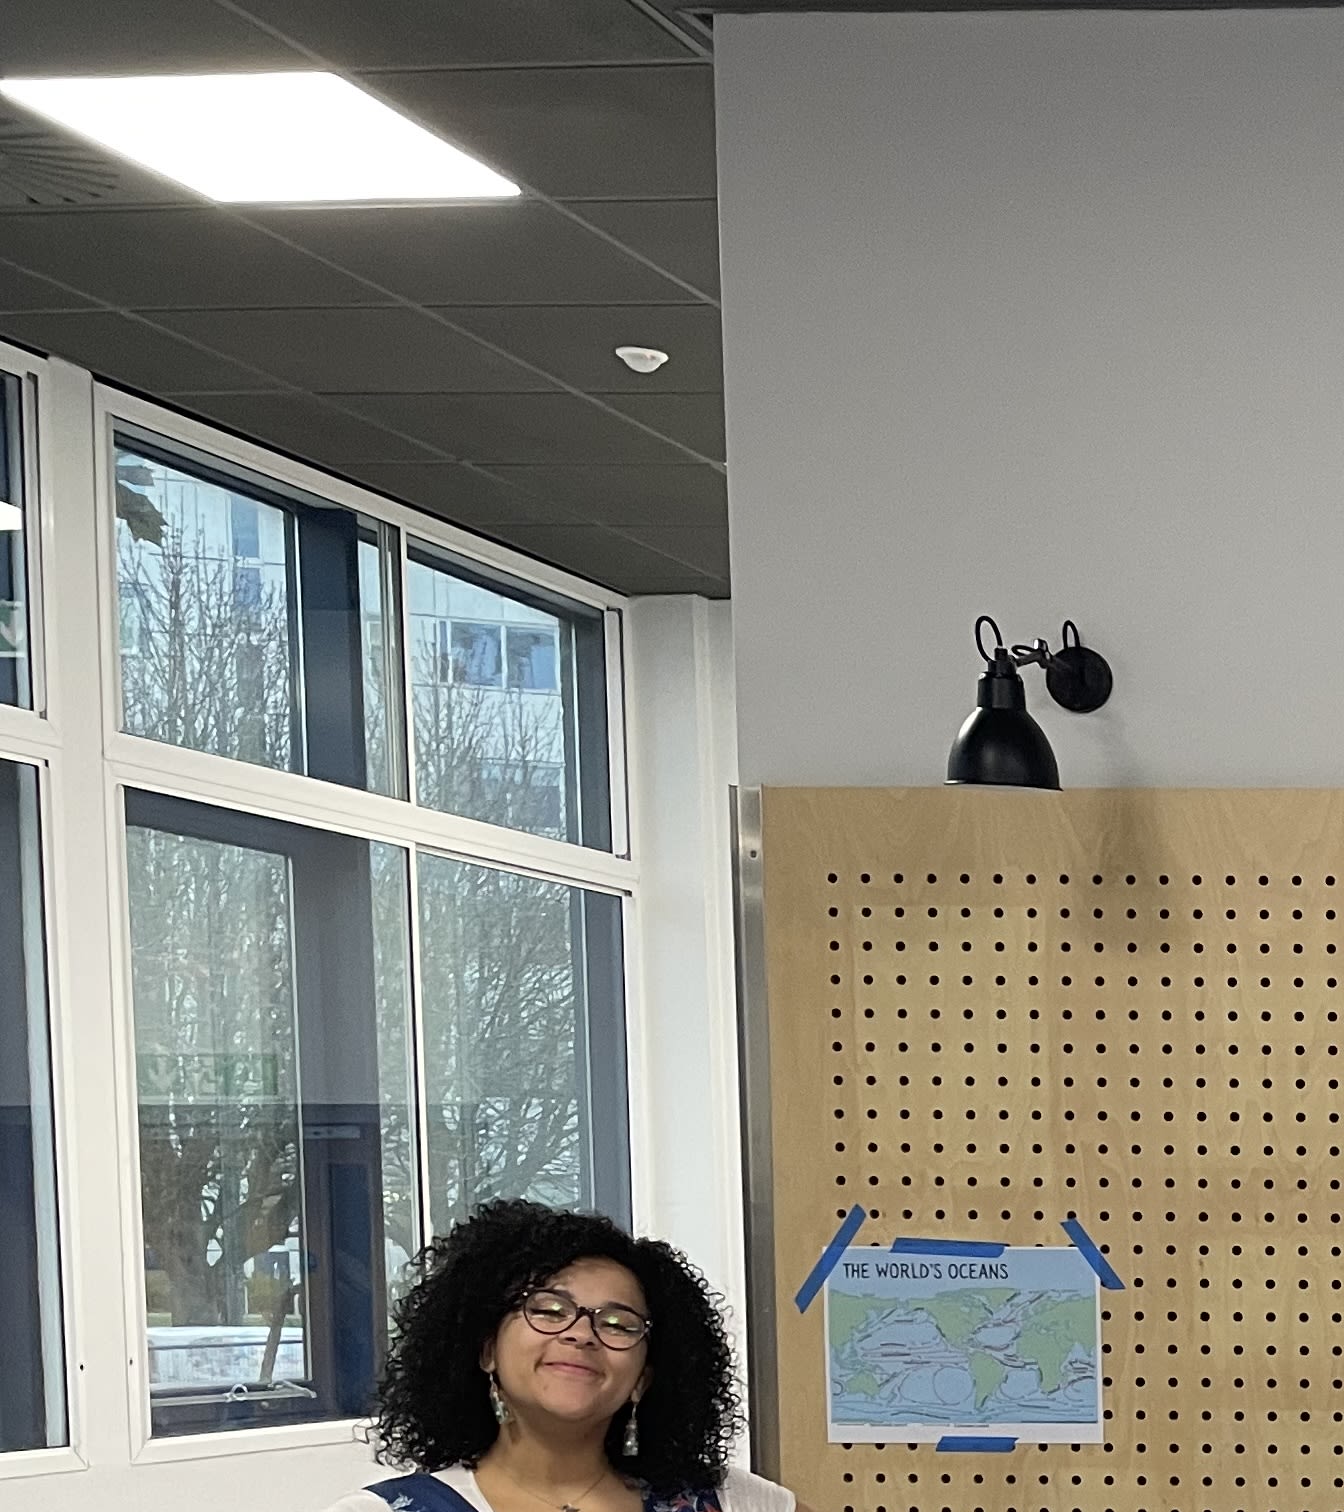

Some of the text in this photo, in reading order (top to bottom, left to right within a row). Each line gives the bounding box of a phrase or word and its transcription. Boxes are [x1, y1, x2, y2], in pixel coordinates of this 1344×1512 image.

[843, 1262, 1009, 1280] THE WORLD'S OCEANS
